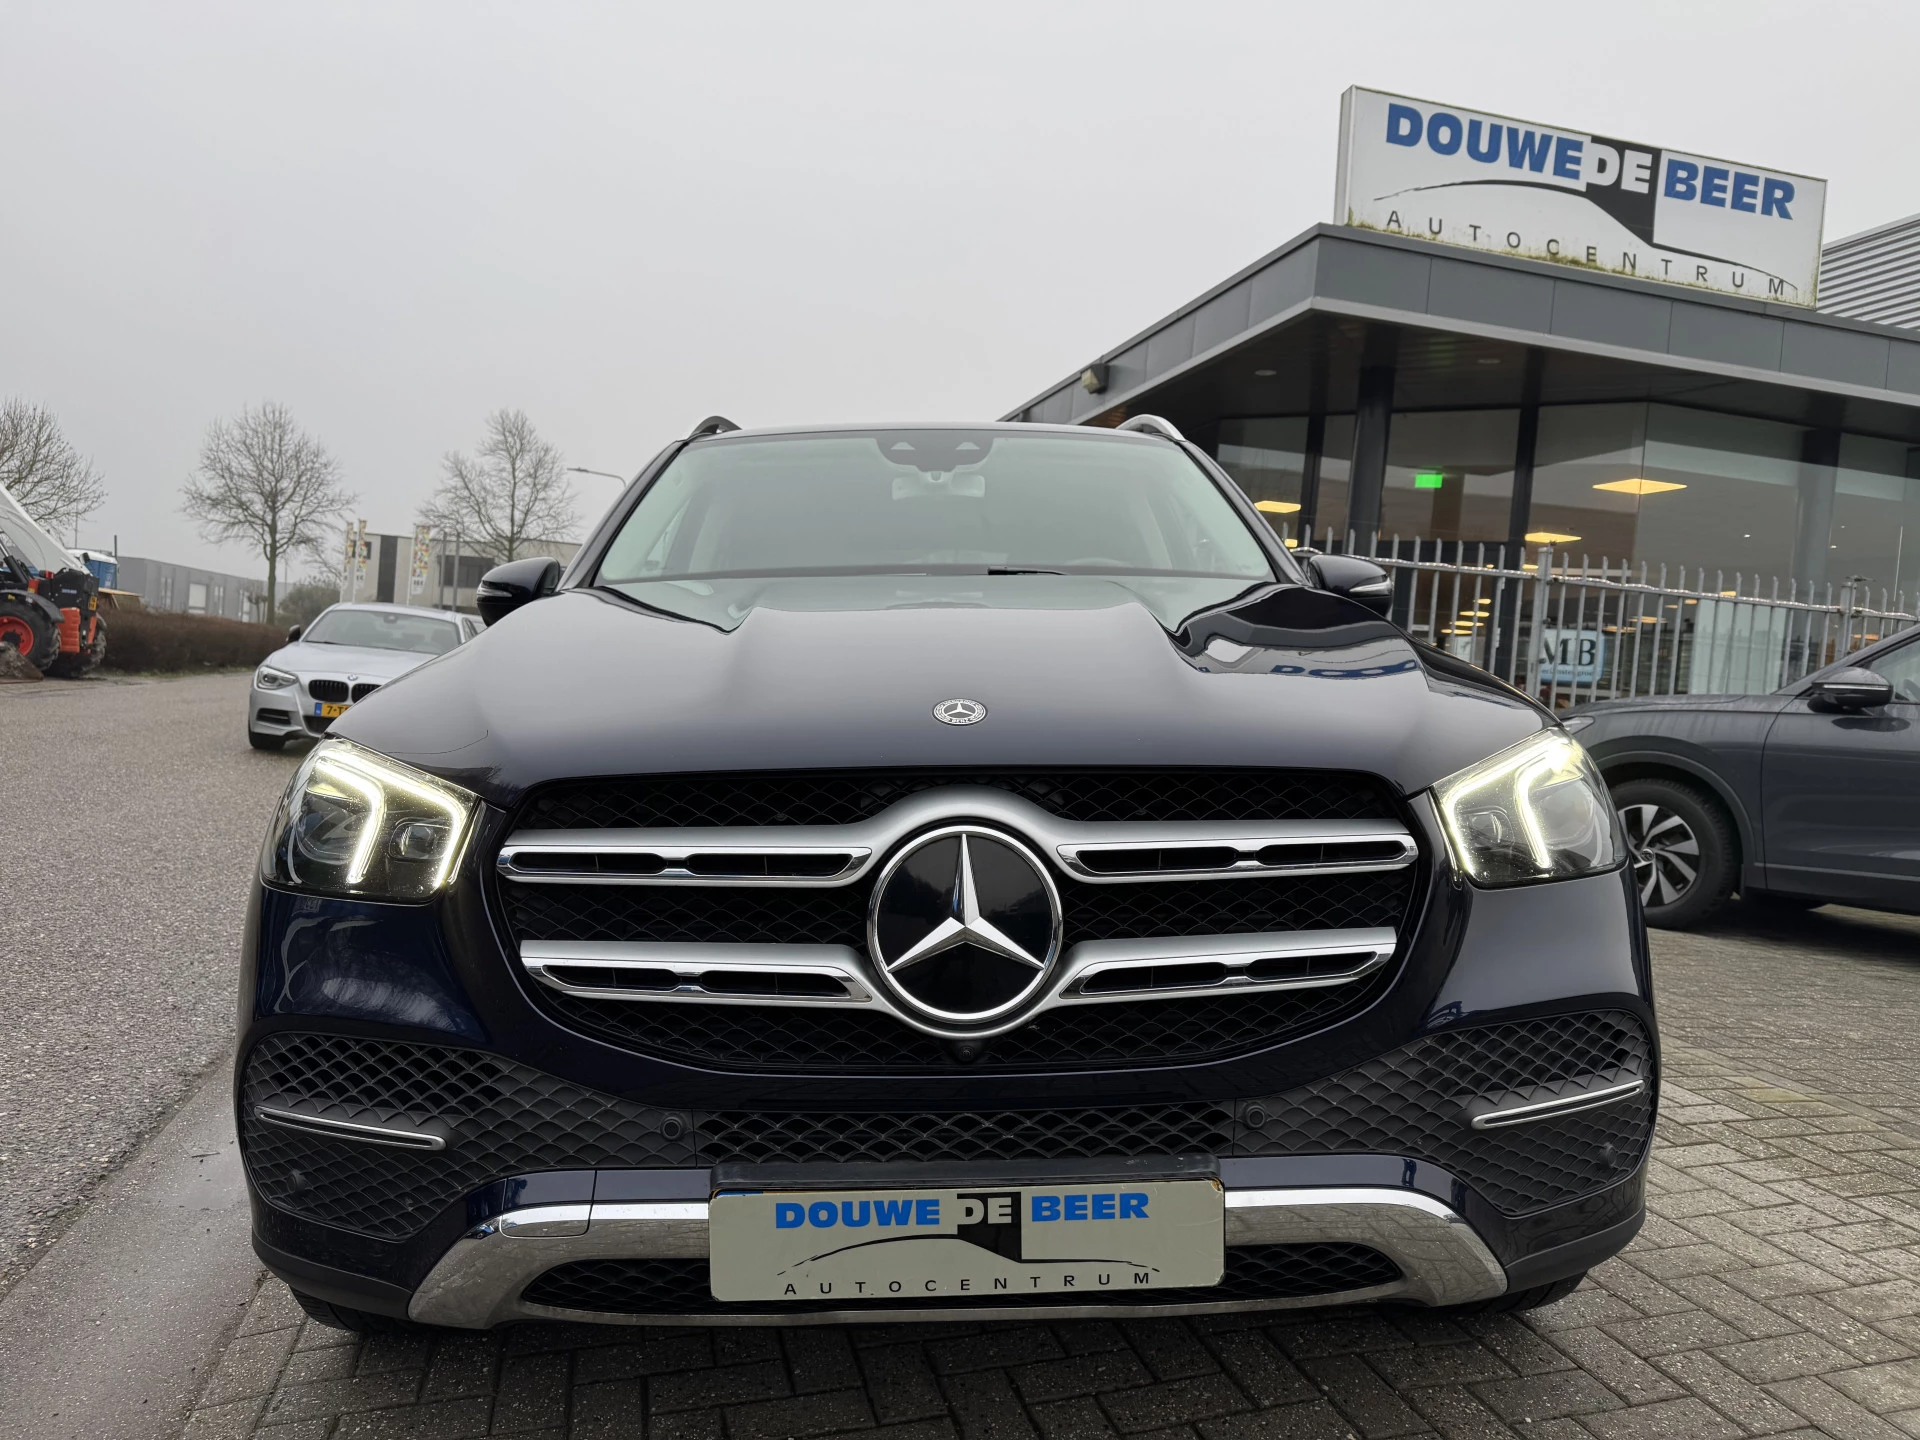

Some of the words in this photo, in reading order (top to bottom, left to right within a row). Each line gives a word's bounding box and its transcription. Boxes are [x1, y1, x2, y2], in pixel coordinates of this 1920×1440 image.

[1386, 104, 1584, 180] DOUWE
[1587, 142, 1653, 194] DE
[1664, 158, 1795, 220] BEER
[1386, 210, 1786, 297] AUTOCENTRUM
[775, 1199, 941, 1230] DOUWE
[957, 1197, 1013, 1225] DE
[1031, 1193, 1150, 1222] BEER
[783, 1272, 1150, 1296] AUTOCENTRUM
